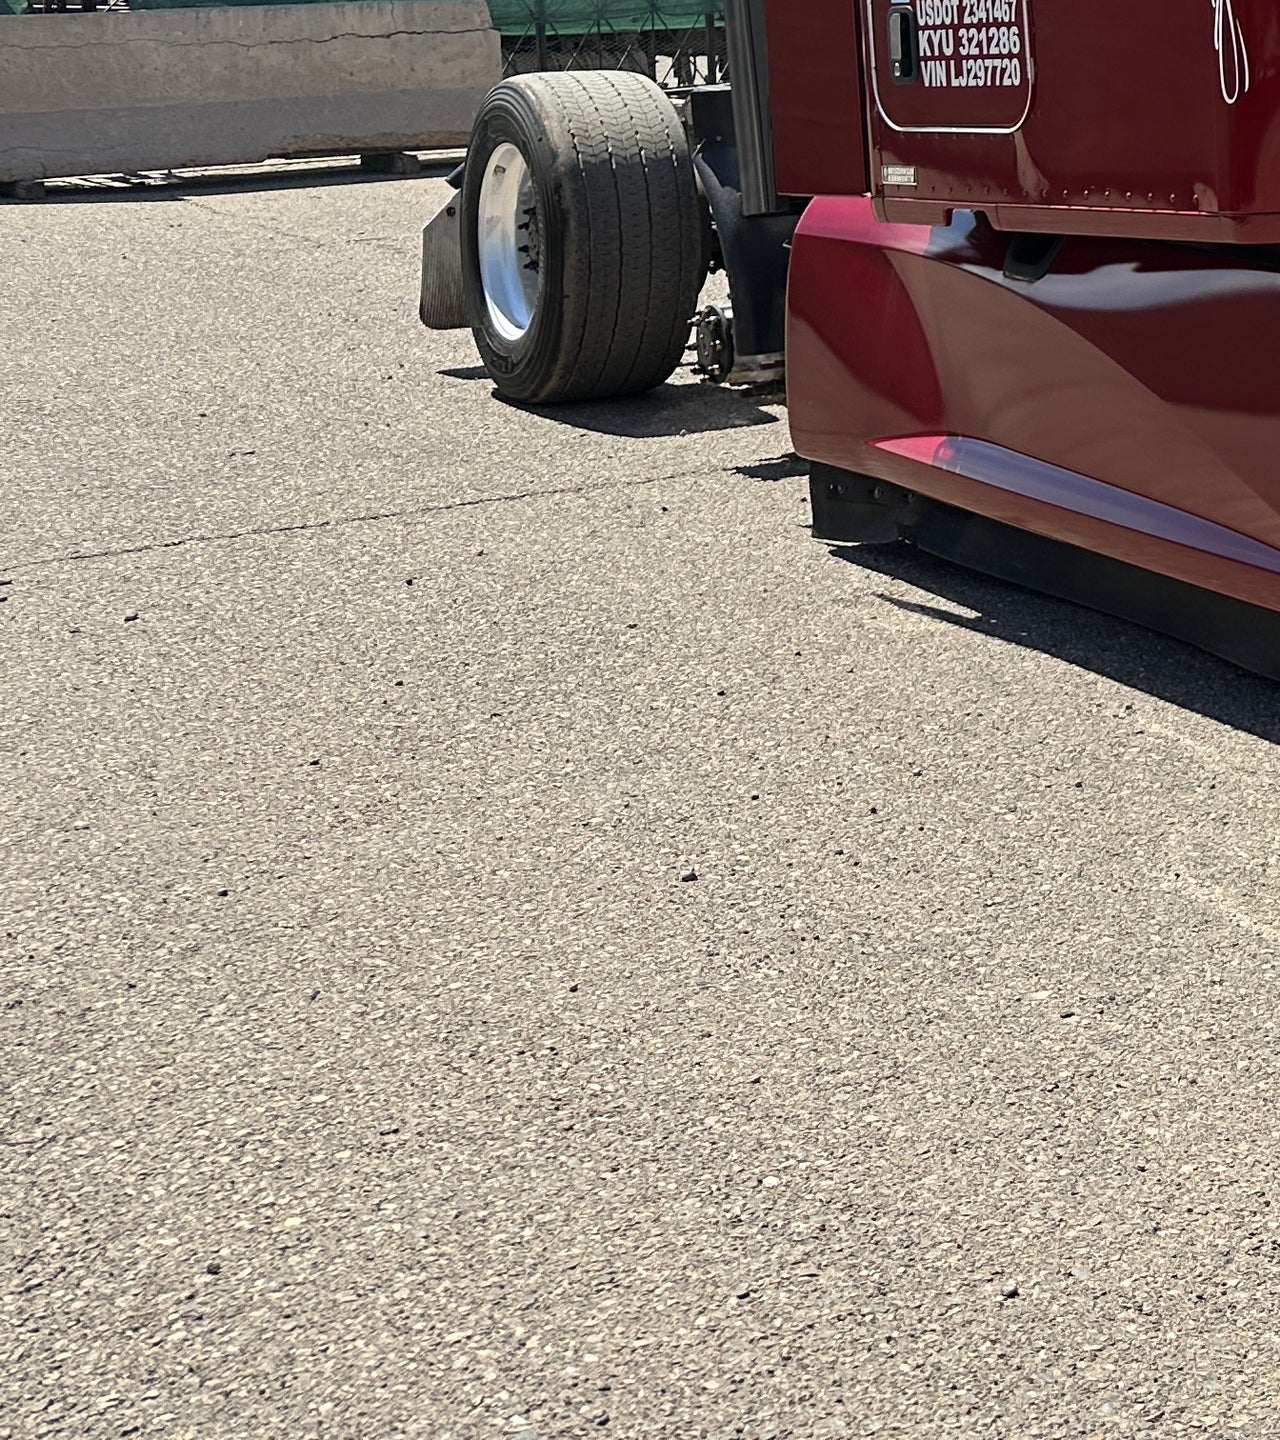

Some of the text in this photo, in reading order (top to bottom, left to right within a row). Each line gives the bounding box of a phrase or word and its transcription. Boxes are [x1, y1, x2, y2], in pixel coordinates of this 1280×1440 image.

[918, 26, 1020, 57] KYU 321286
[920, 58, 1020, 87] VIN LJ297720
